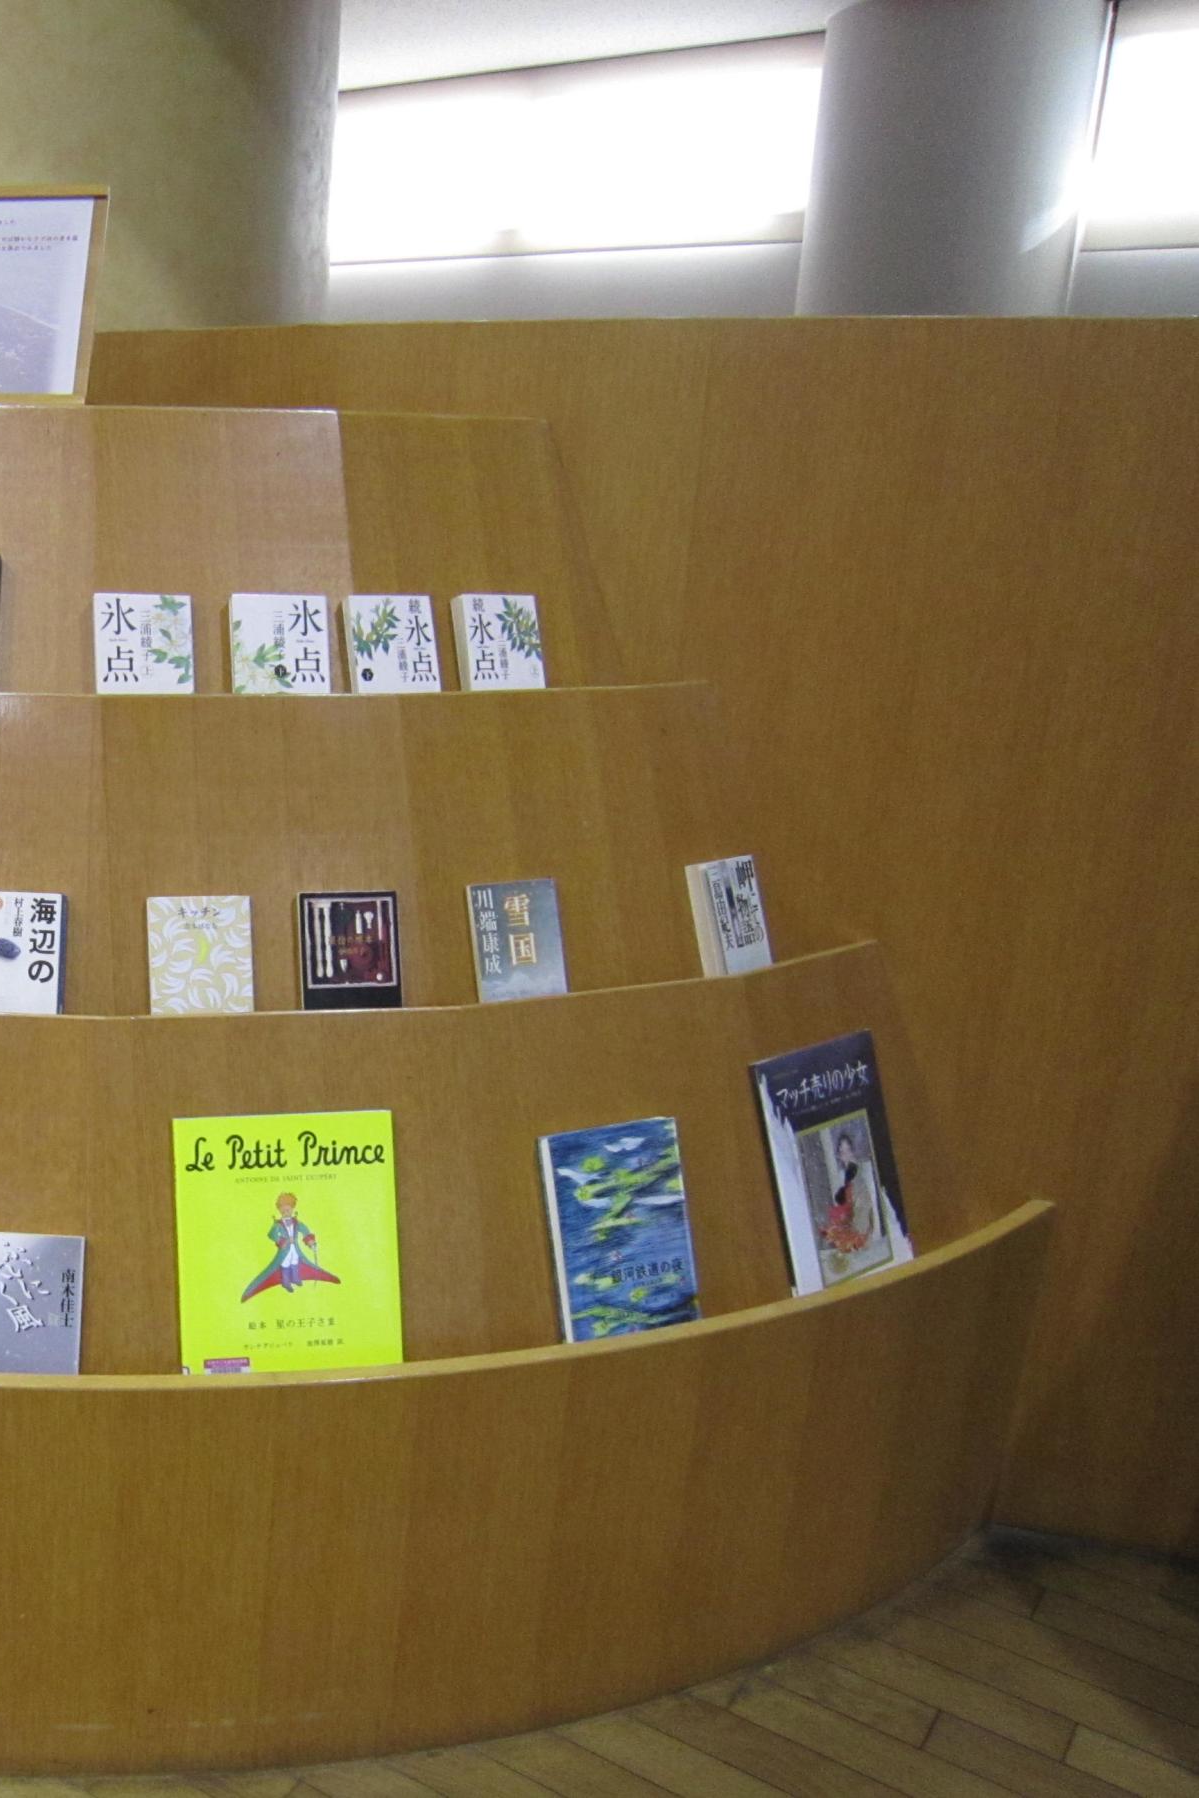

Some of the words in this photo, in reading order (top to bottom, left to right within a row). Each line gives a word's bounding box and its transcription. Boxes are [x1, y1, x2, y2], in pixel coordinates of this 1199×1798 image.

[100, 598, 139, 683] 氷点
[288, 599, 325, 683] 氷点
[28, 897, 57, 984] 海辺の
[178, 906, 220, 918] キッチン
[475, 887, 502, 976] 川端康成
[504, 893, 537, 966] 雪国
[775, 1061, 870, 1109] マッチ売りの少女
[186, 1137, 215, 1172] Le
[226, 1134, 287, 1169] Petit
[298, 1131, 385, 1167] Prince
